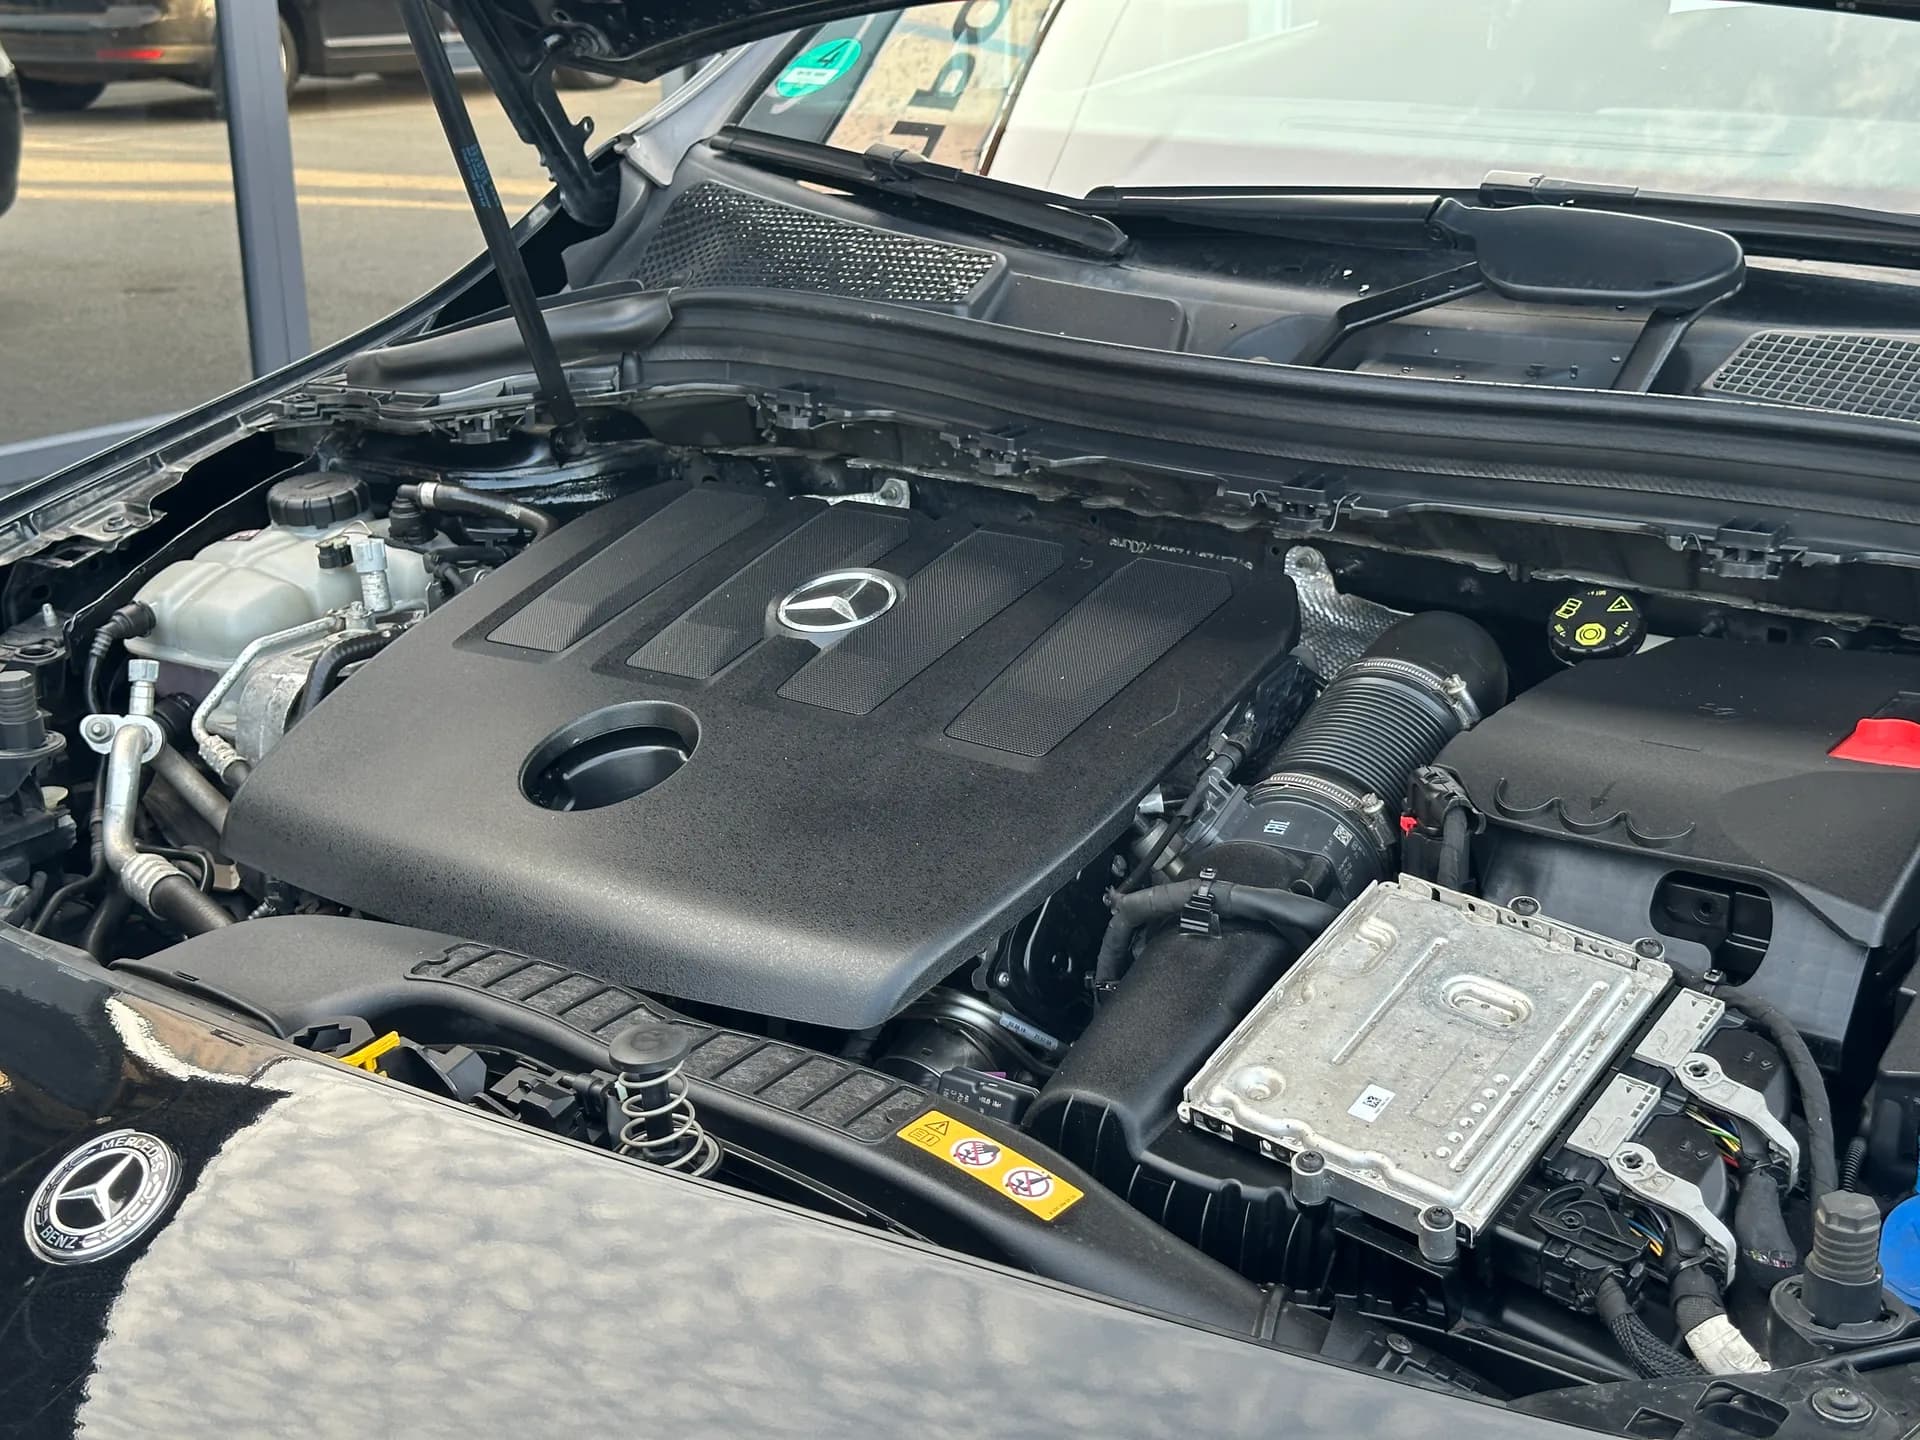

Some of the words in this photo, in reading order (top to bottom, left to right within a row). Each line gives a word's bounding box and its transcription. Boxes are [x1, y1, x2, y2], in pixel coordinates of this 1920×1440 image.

[817, 40, 851, 68] 4
[101, 1136, 164, 1173] MERCEDES
[40, 1226, 76, 1249] BENZ
